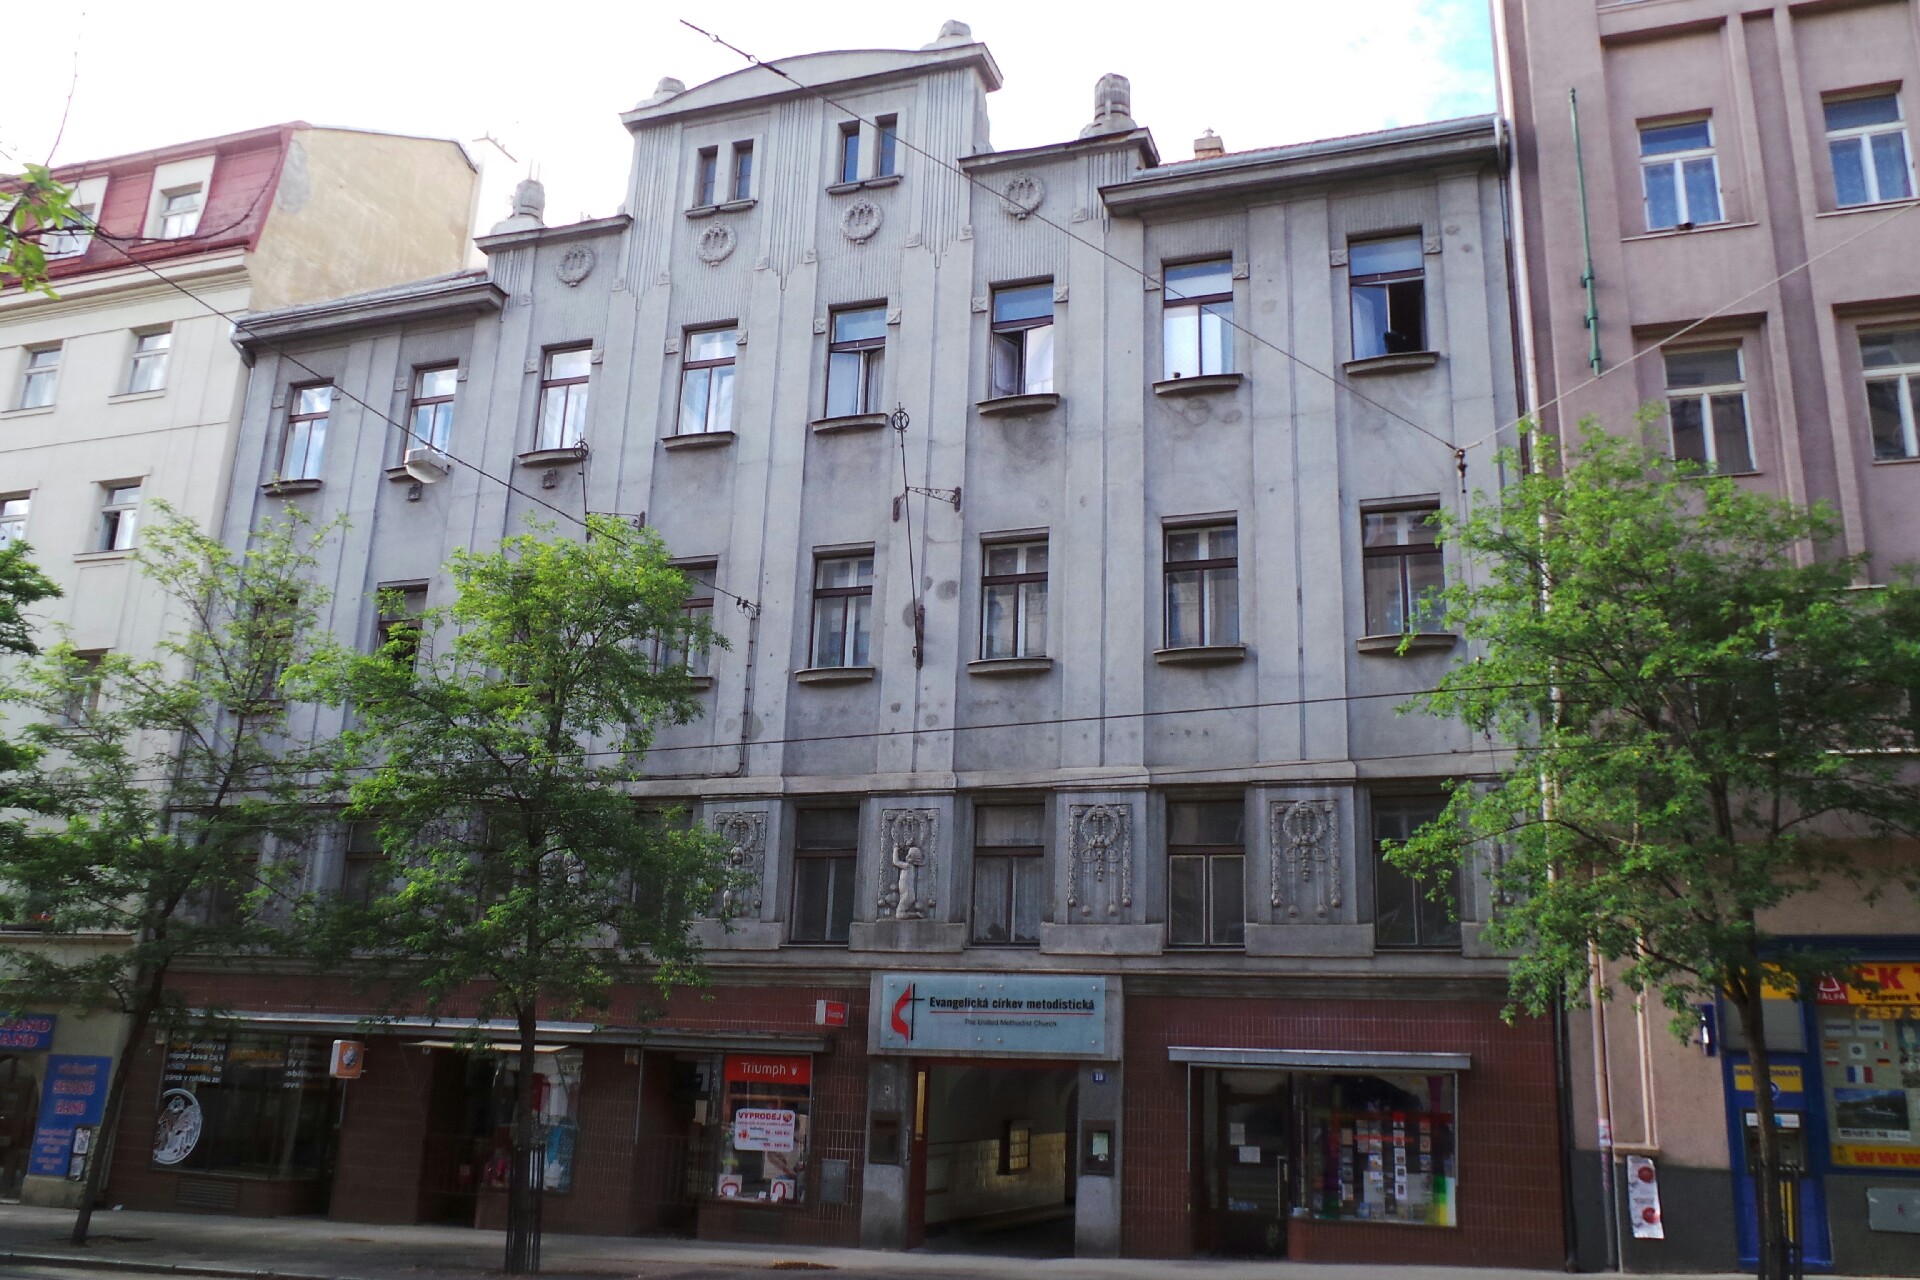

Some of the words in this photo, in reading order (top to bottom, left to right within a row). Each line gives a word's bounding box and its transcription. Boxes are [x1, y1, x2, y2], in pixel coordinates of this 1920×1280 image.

[929, 996, 988, 1010] Evangelická
[992, 997, 1023, 1009] církev
[1026, 998, 1095, 1010] metodistická
[1000, 1019, 1032, 1027] Methodist
[1033, 1019, 1057, 1027] Church
[741, 1062, 786, 1078] Triumph
